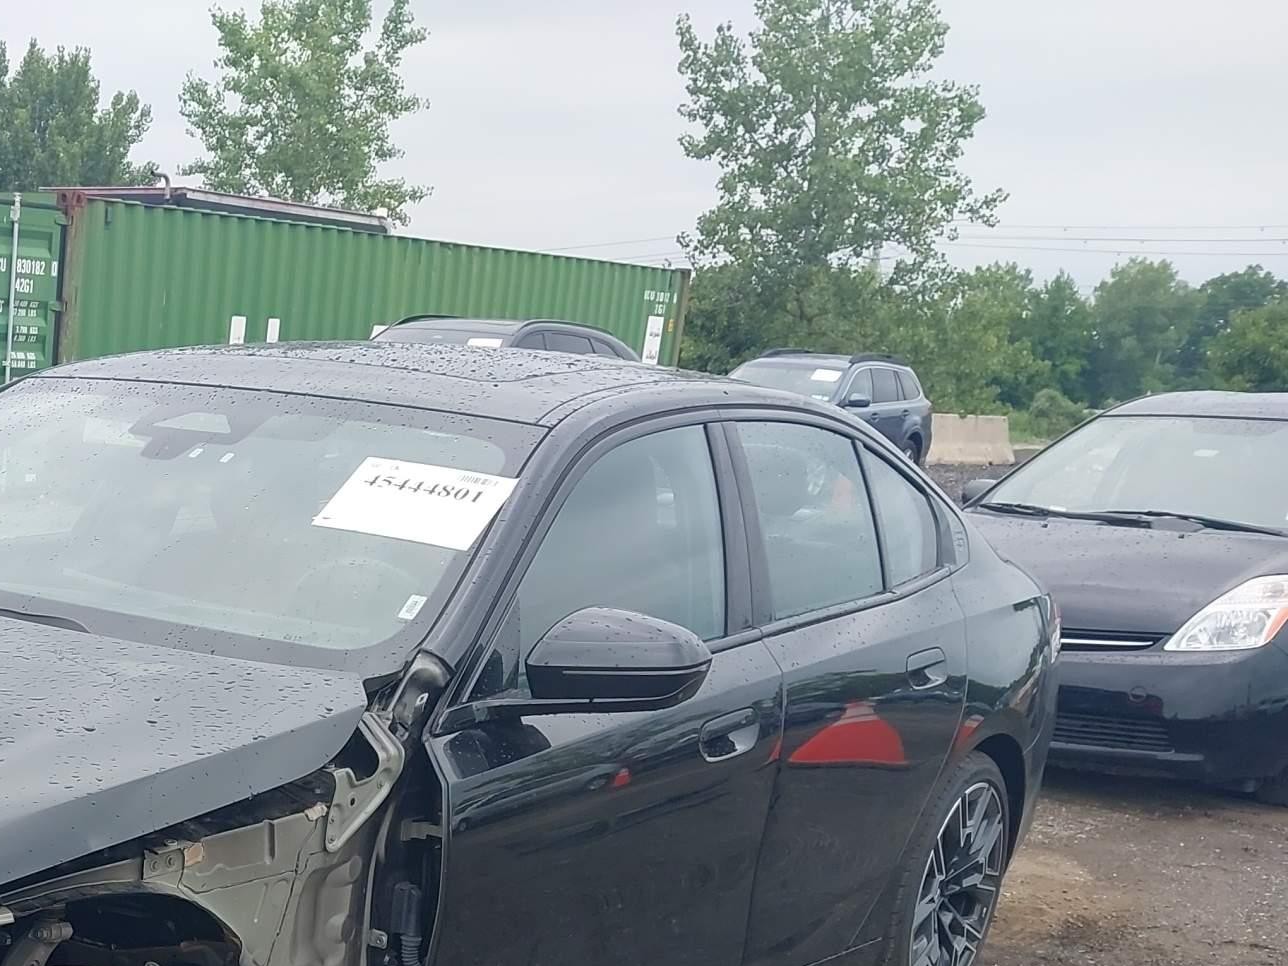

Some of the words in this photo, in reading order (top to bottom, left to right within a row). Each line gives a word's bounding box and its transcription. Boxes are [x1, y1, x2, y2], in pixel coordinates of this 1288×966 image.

[16, 258, 46, 276] 830182
[15, 277, 34, 293] 42G1
[364, 475, 483, 503] 45444801
